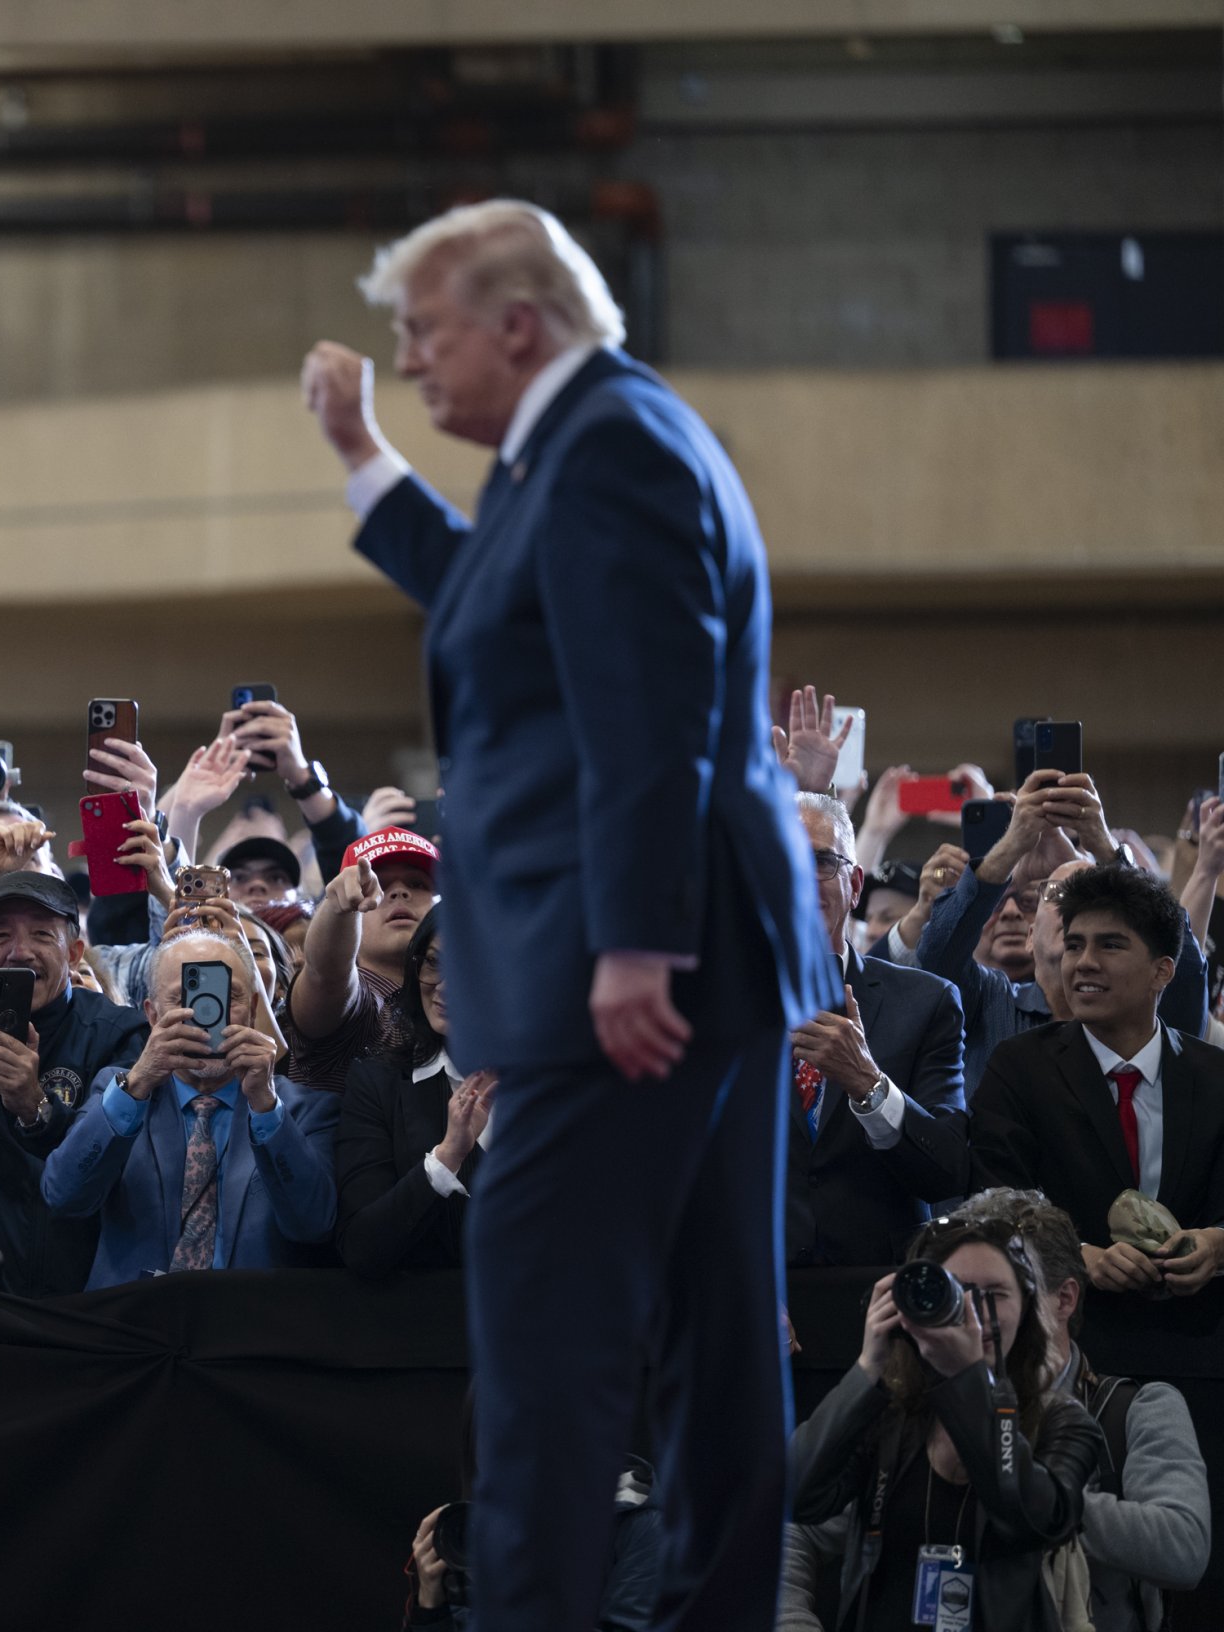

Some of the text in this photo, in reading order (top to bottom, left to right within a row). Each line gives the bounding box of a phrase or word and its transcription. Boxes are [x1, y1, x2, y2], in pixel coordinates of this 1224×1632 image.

[353, 832, 436, 857] MAKE AMERICA
[1001, 1418, 1013, 1474] SONY
[871, 1470, 889, 1525] SONY
